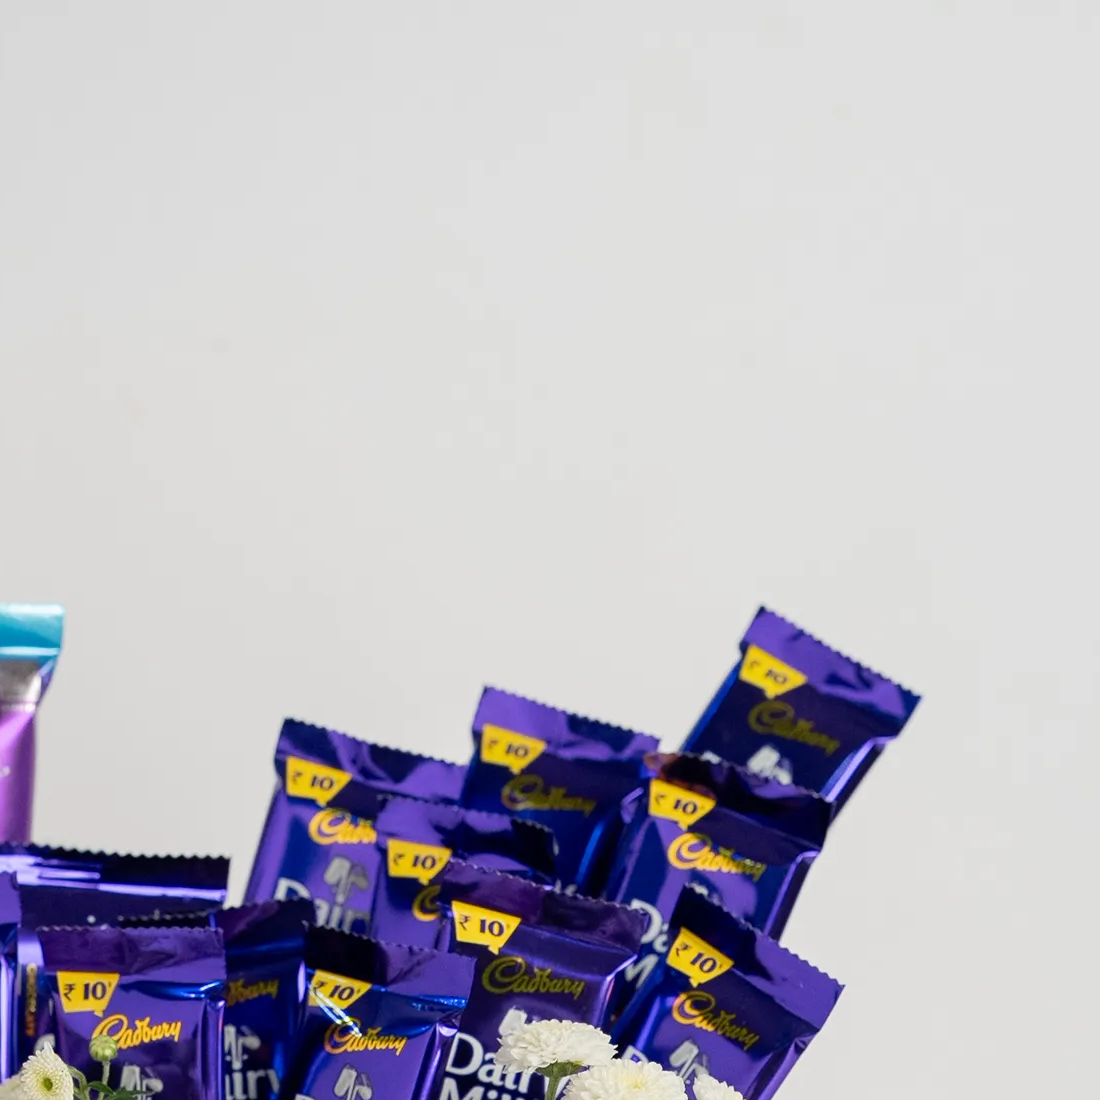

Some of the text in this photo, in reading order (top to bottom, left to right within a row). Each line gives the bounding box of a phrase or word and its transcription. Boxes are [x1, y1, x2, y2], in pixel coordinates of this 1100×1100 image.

[481, 956, 586, 1000] Cadbury
[91, 1014, 182, 1050] Cadbury
[324, 1016, 408, 1056] Cadbury
[671, 990, 760, 1051] Cadbury
